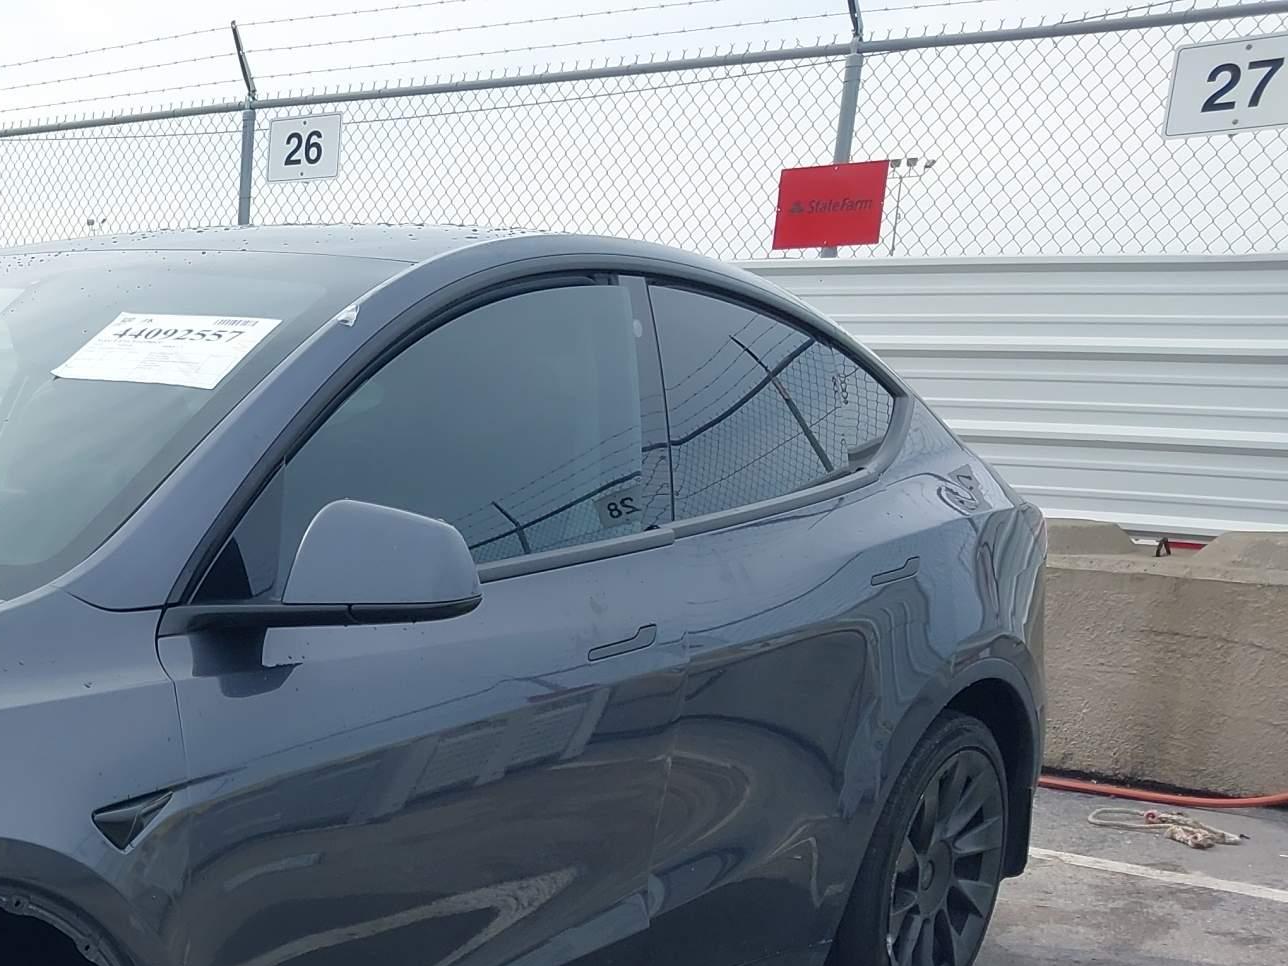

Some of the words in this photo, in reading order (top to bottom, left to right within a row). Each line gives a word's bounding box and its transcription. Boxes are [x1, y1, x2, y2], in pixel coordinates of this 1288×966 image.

[1200, 57, 1285, 113] 27
[284, 130, 322, 166] 26
[112, 327, 246, 343] 44092557
